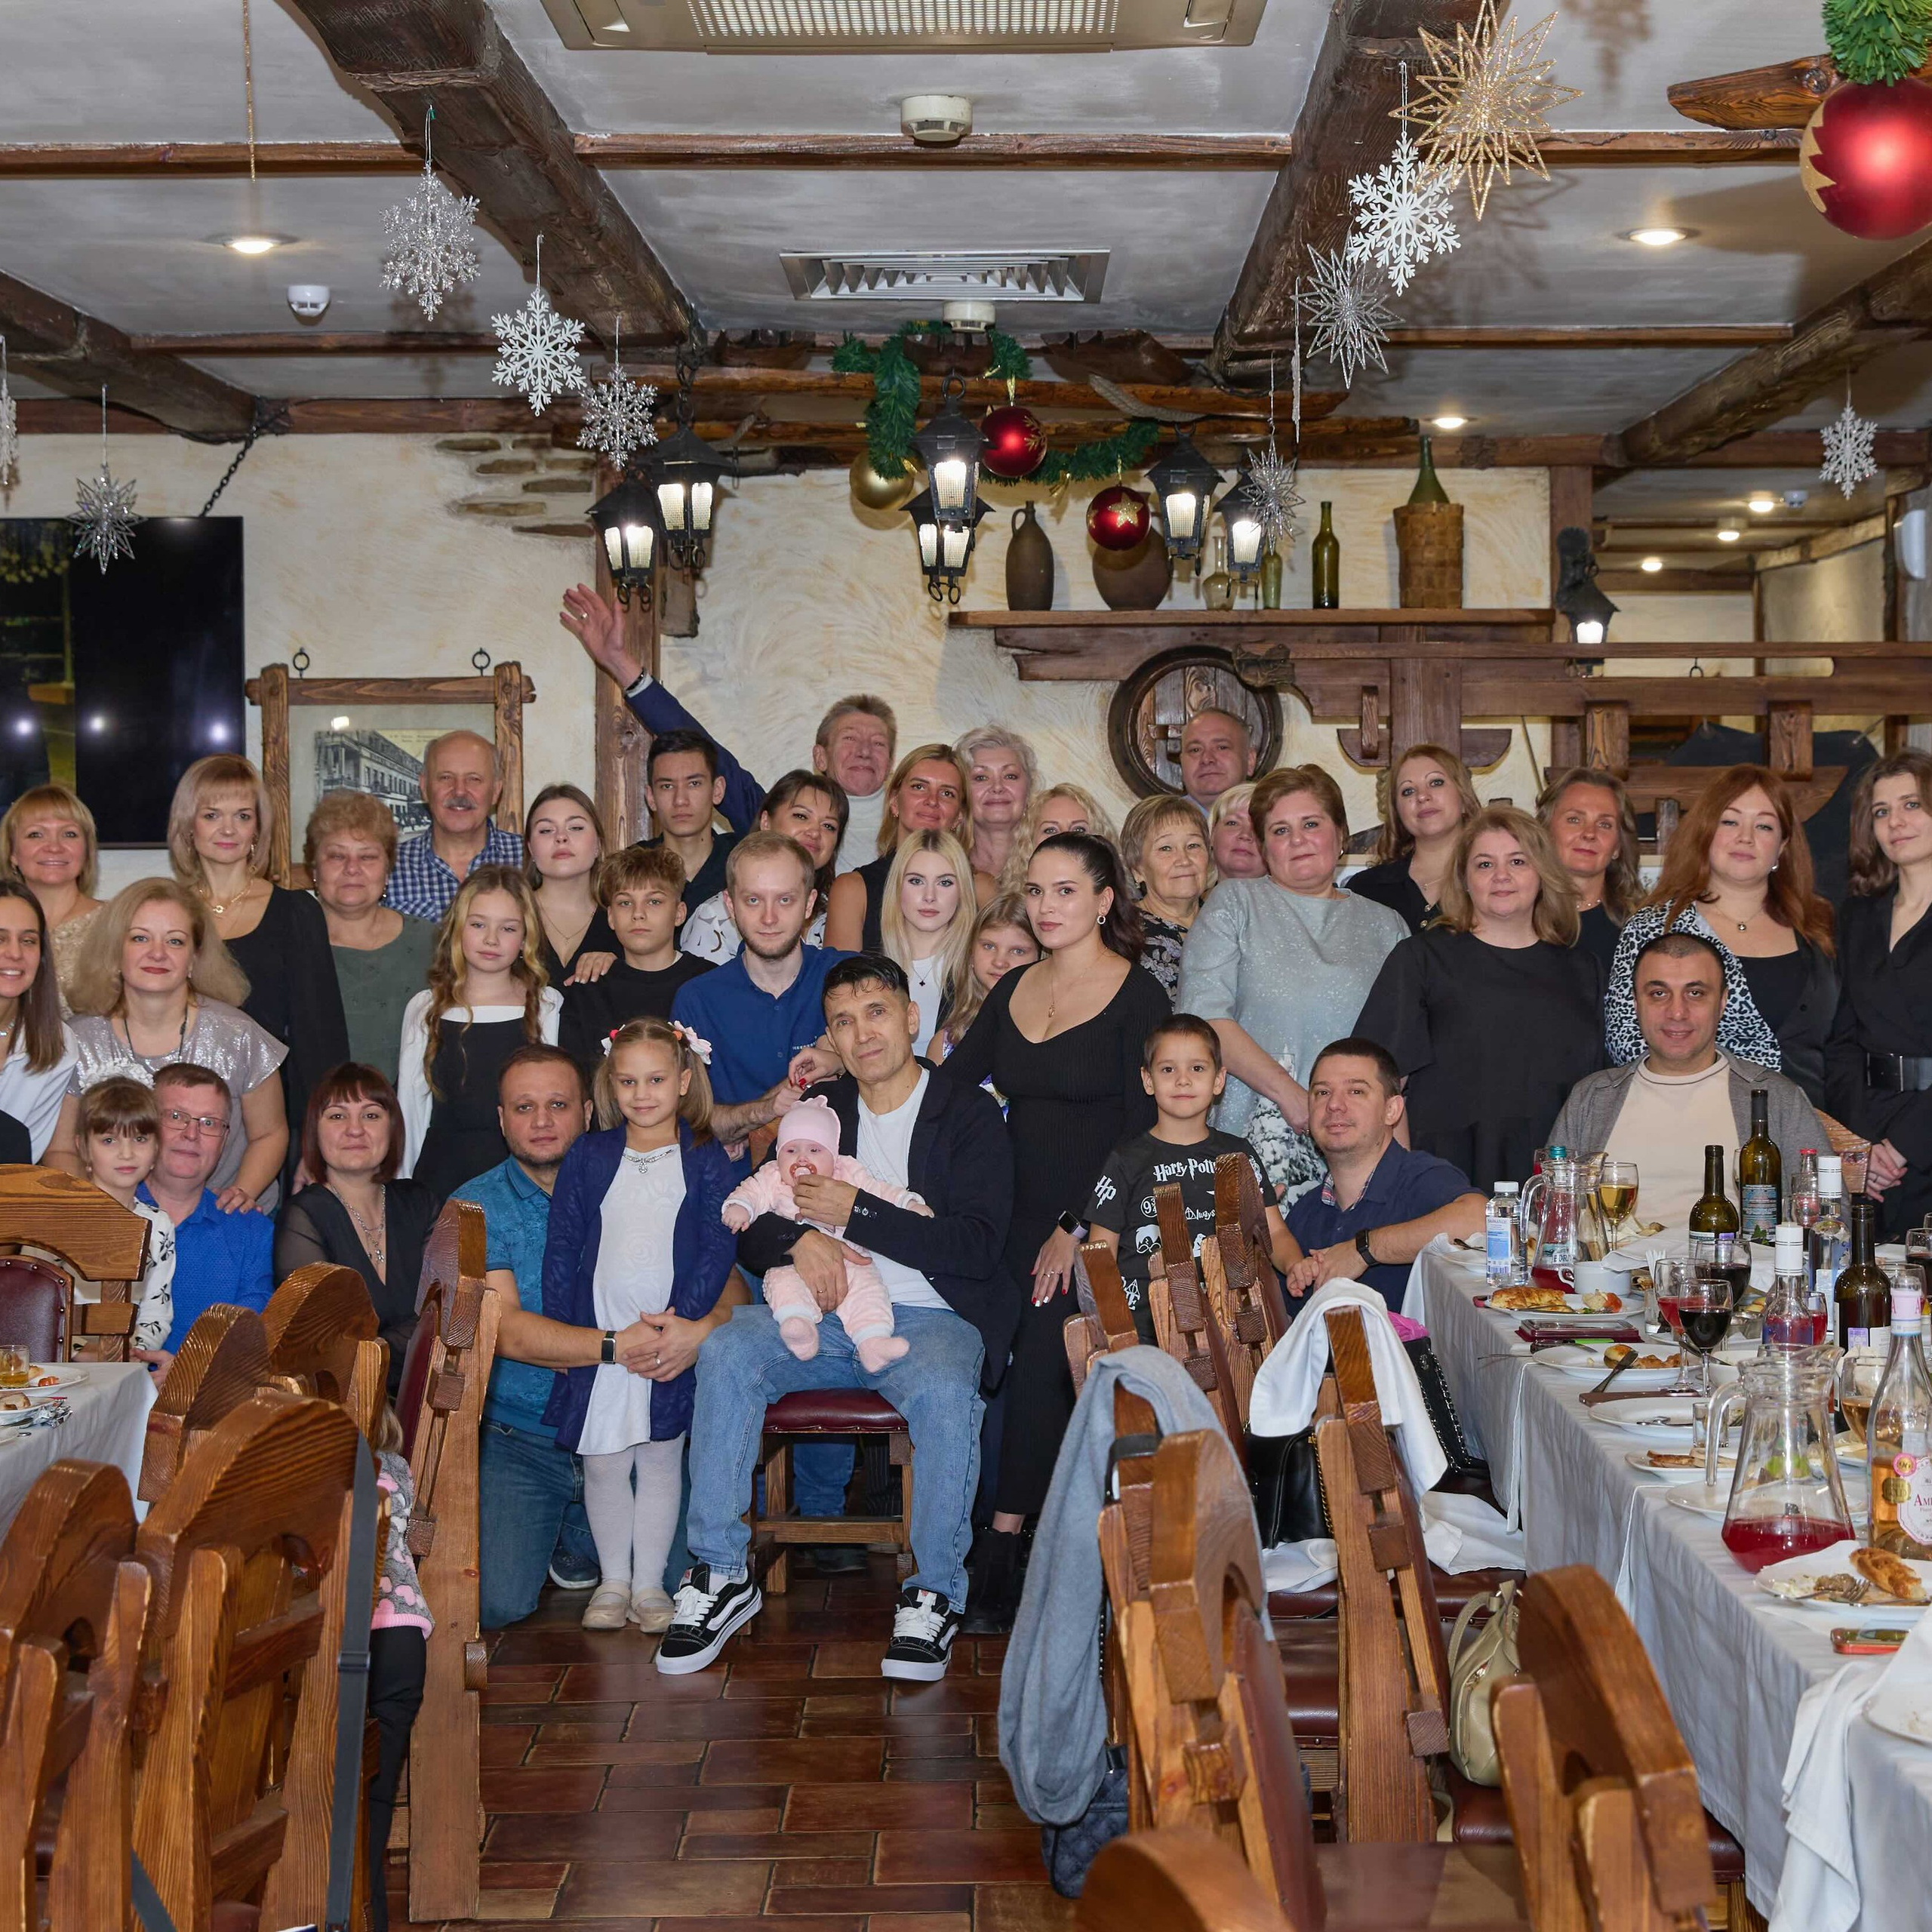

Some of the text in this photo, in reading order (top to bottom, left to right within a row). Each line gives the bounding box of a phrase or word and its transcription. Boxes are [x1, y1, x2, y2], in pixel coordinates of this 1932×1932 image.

[1153, 1158, 1216, 1182] Harry Pott
[1094, 1175, 1117, 1209] HP
